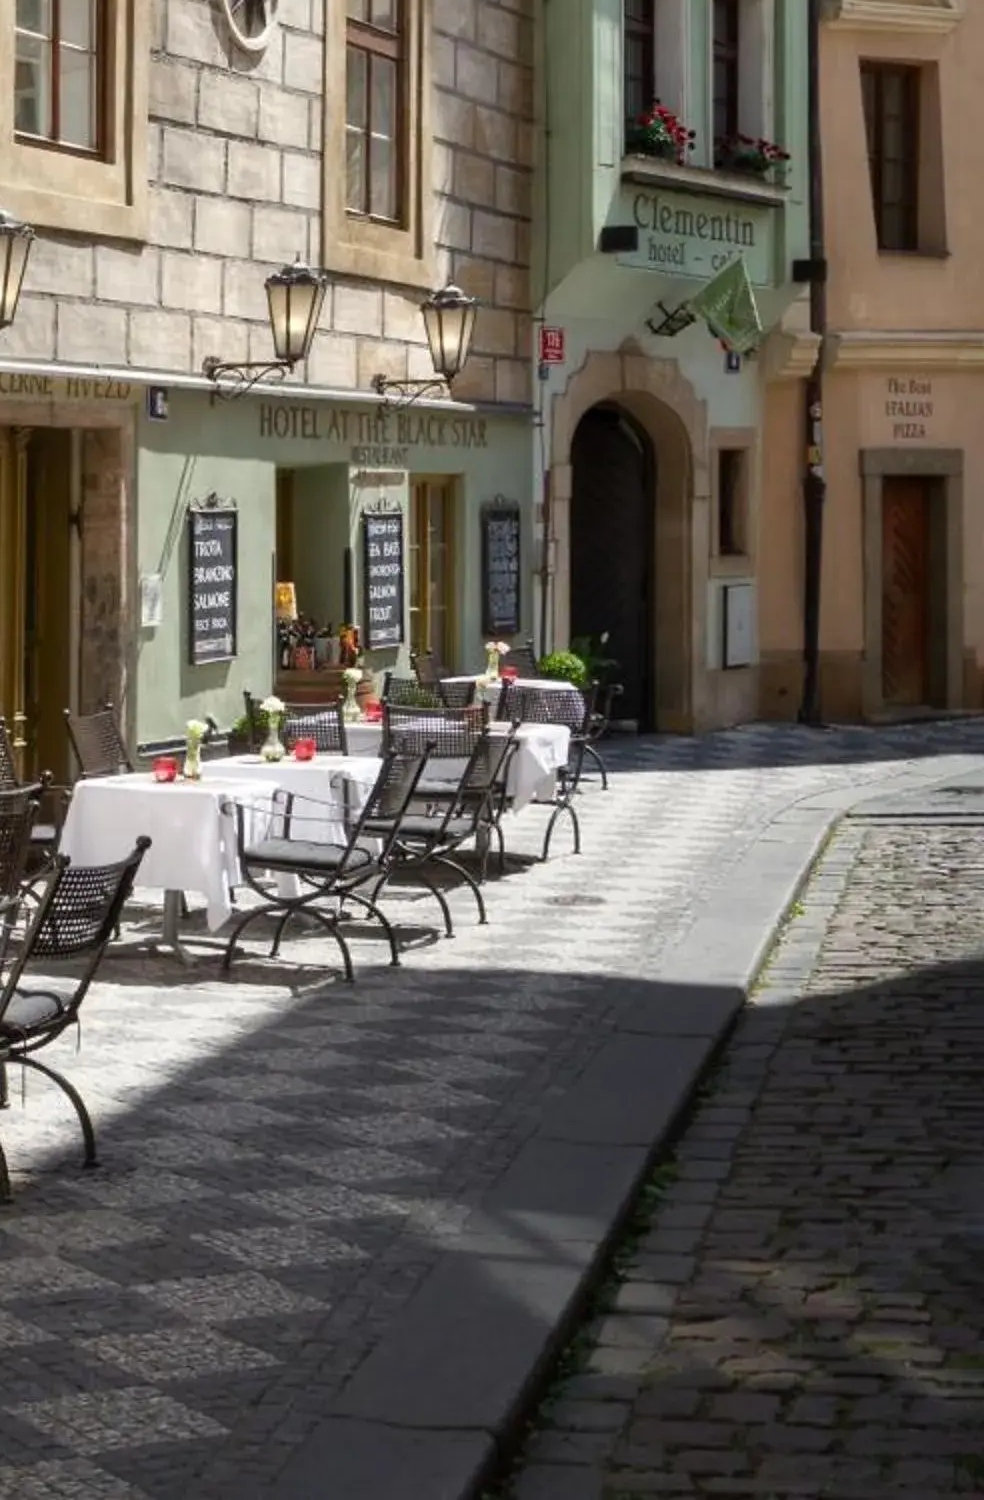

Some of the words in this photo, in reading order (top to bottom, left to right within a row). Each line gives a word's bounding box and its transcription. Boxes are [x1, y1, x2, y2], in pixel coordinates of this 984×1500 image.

[633, 193, 755, 247] Clementin
[648, 236, 686, 266] hotel
[888, 378, 906, 395] The
[909, 379, 932, 396] Best
[885, 400, 934, 417] ITALIAN
[259, 403, 321, 439] HOTEL
[328, 409, 350, 442] AT
[354, 411, 392, 444] THE
[397, 413, 447, 446] BLACK
[452, 417, 489, 449] STAR
[893, 423, 926, 439] PIZZA
